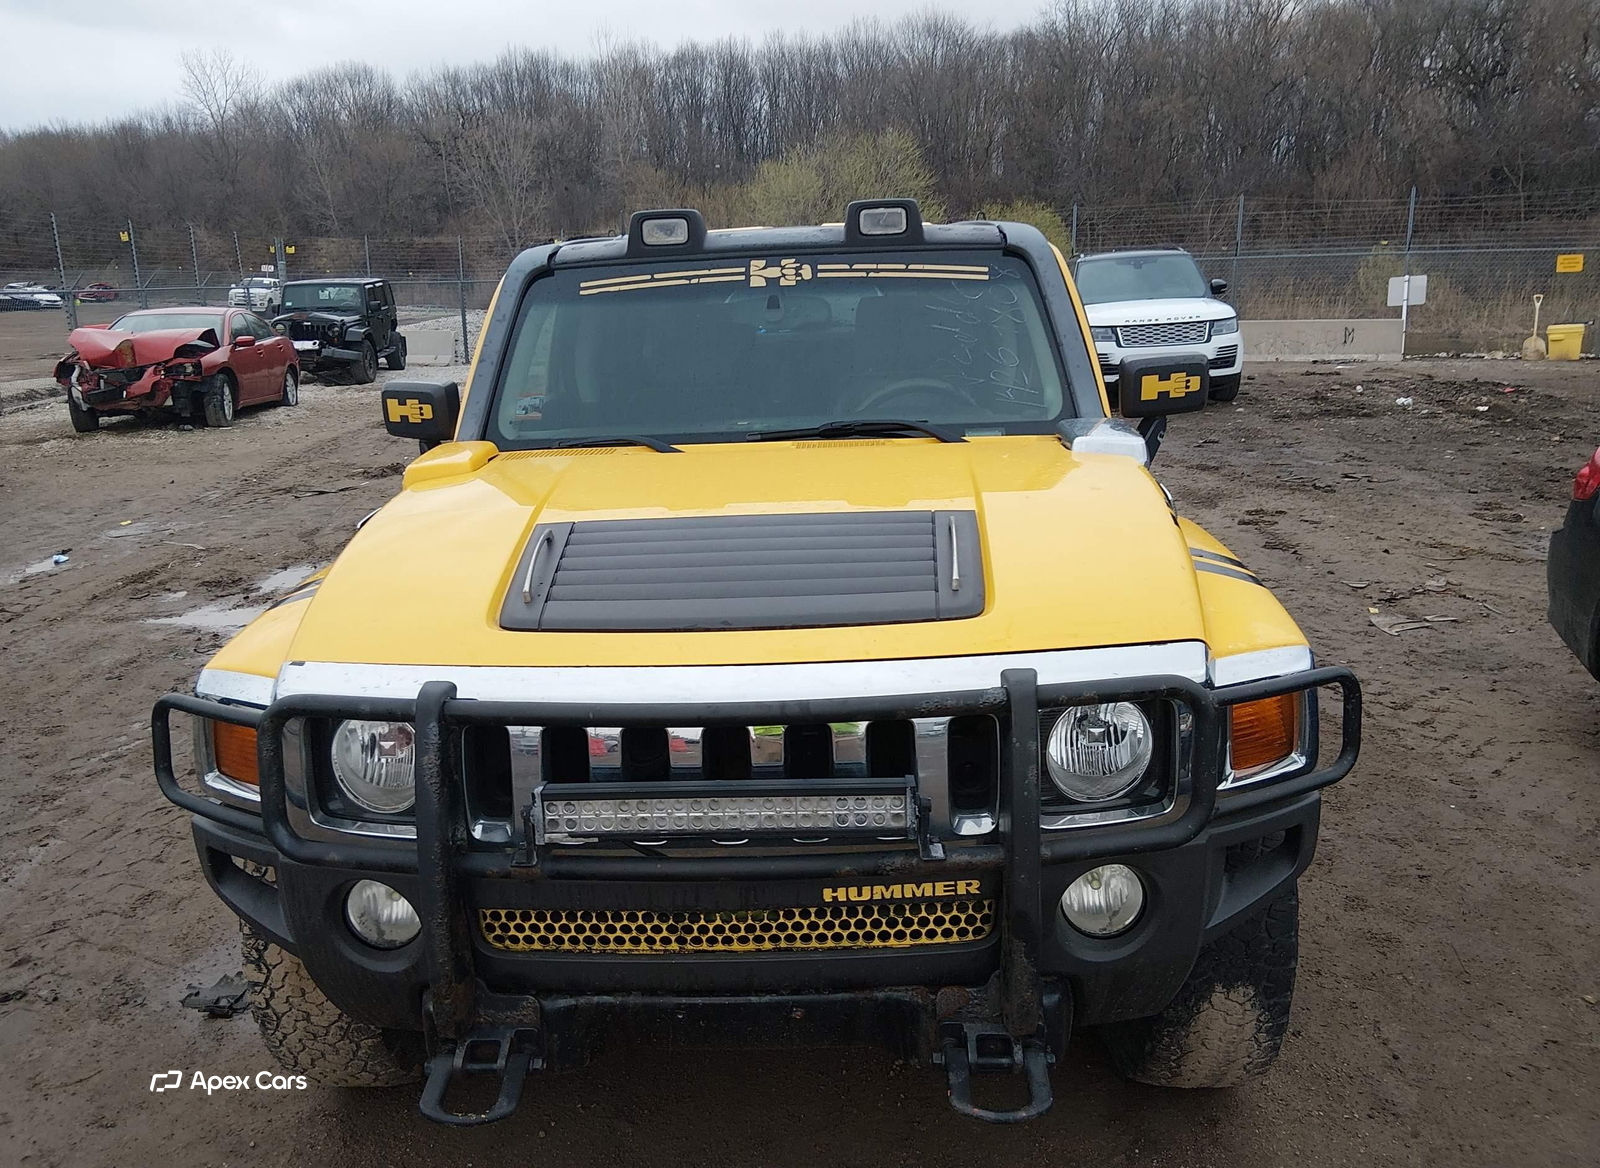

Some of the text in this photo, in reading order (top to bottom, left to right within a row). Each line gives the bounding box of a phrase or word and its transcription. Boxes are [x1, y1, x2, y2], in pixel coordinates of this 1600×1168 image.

[1166, 314, 1201, 322] ROVER
[1140, 371, 1202, 401] H3
[386, 398, 434, 424] H3
[822, 879, 982, 903] HUMMER
